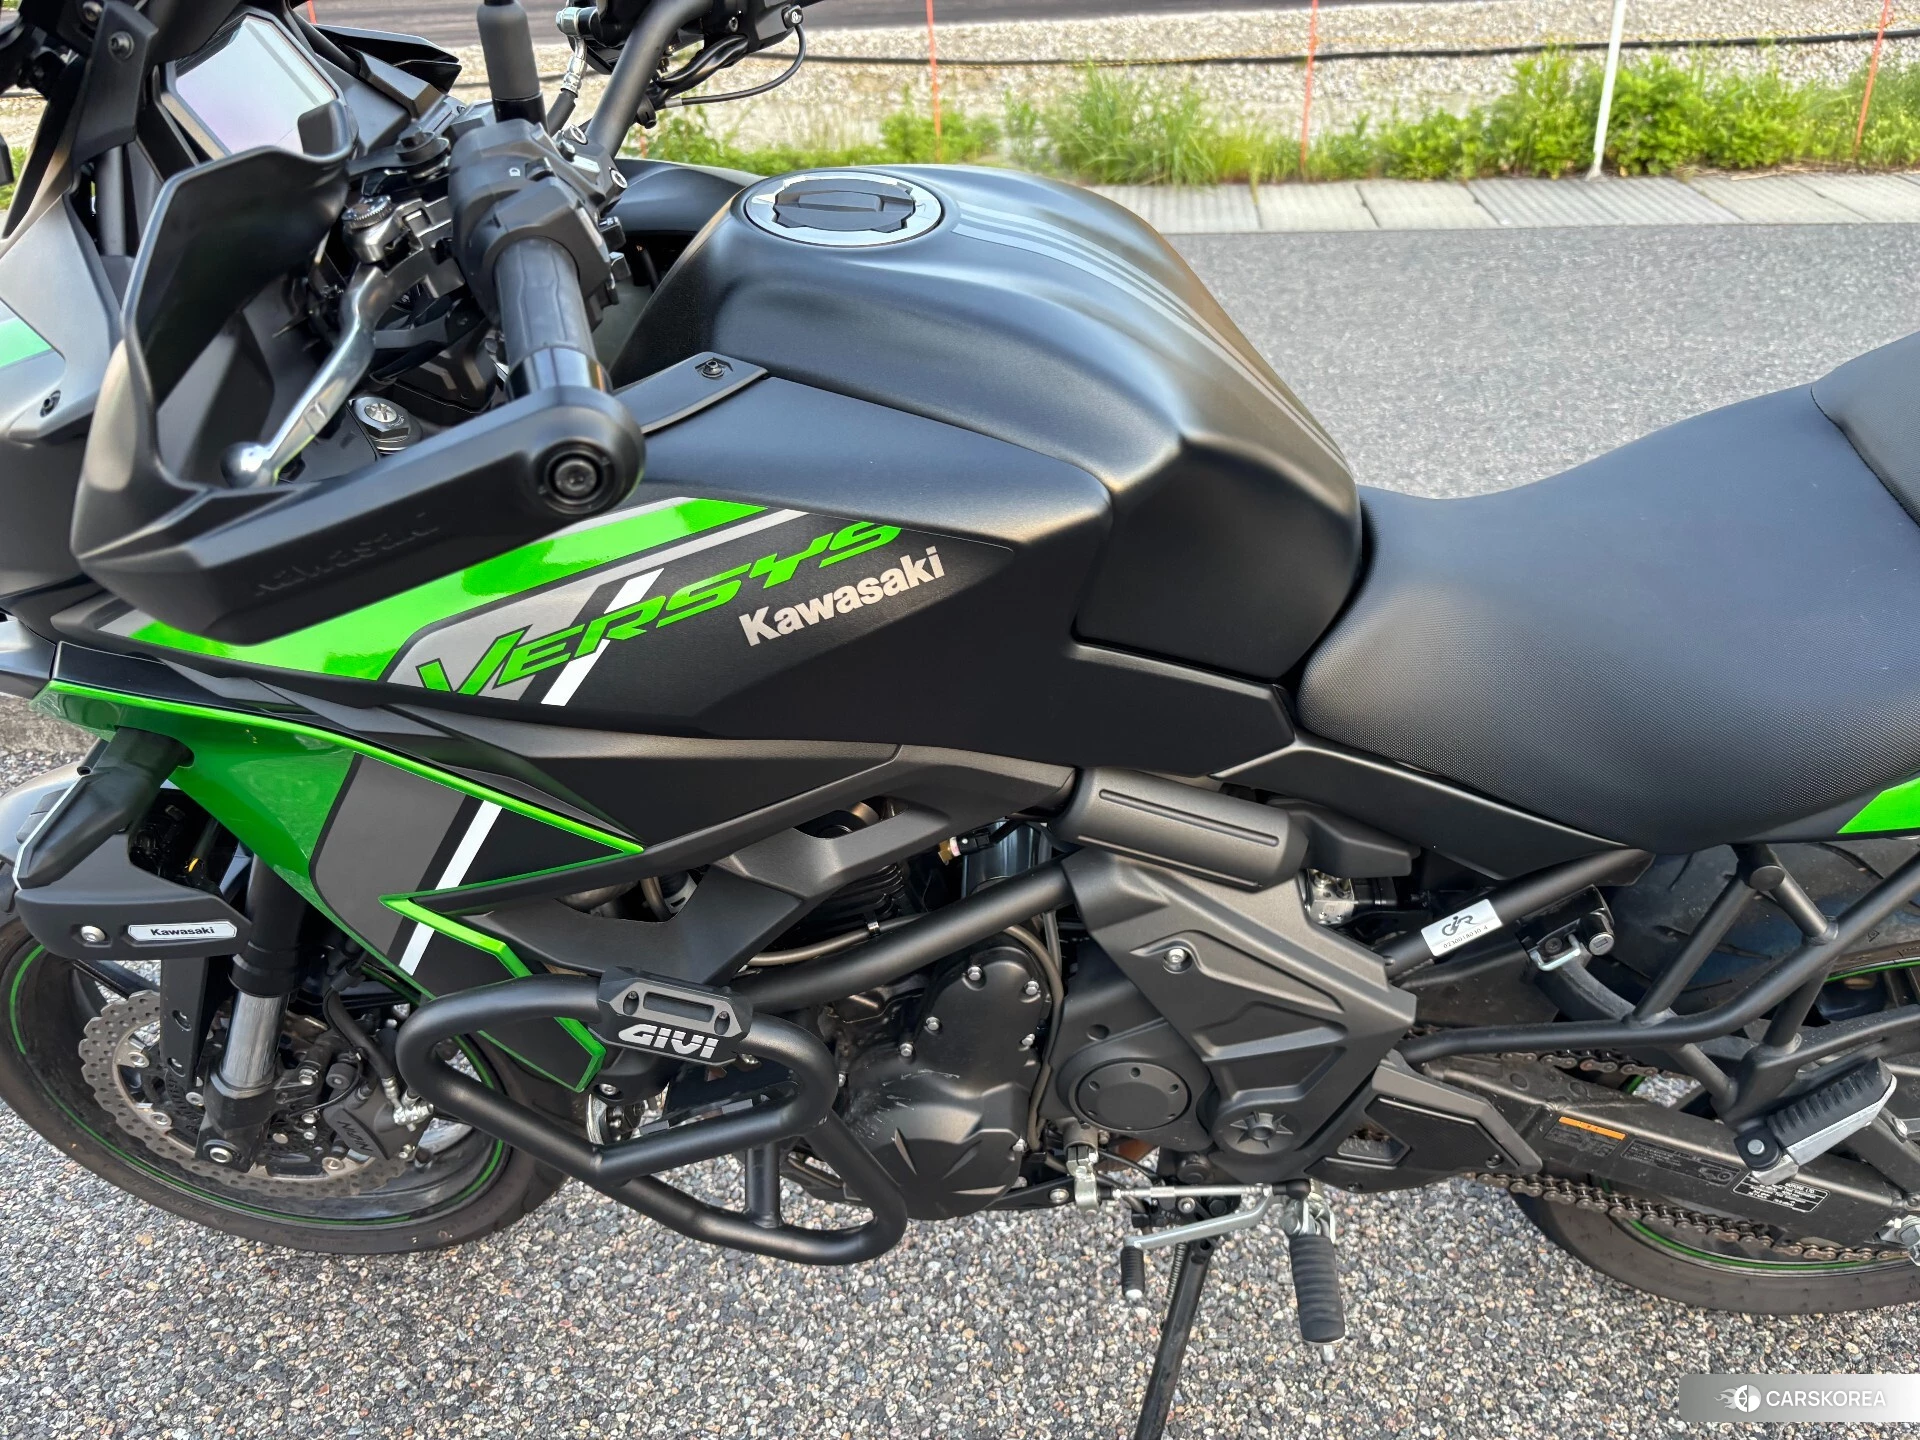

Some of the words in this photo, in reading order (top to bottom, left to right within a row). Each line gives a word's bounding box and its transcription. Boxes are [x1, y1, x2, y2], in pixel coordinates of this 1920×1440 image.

[416, 521, 901, 696] VERSYS
[739, 546, 945, 646] Kawasaki
[150, 926, 215, 936] Kawasaki
[618, 1023, 719, 1059] GIVI
